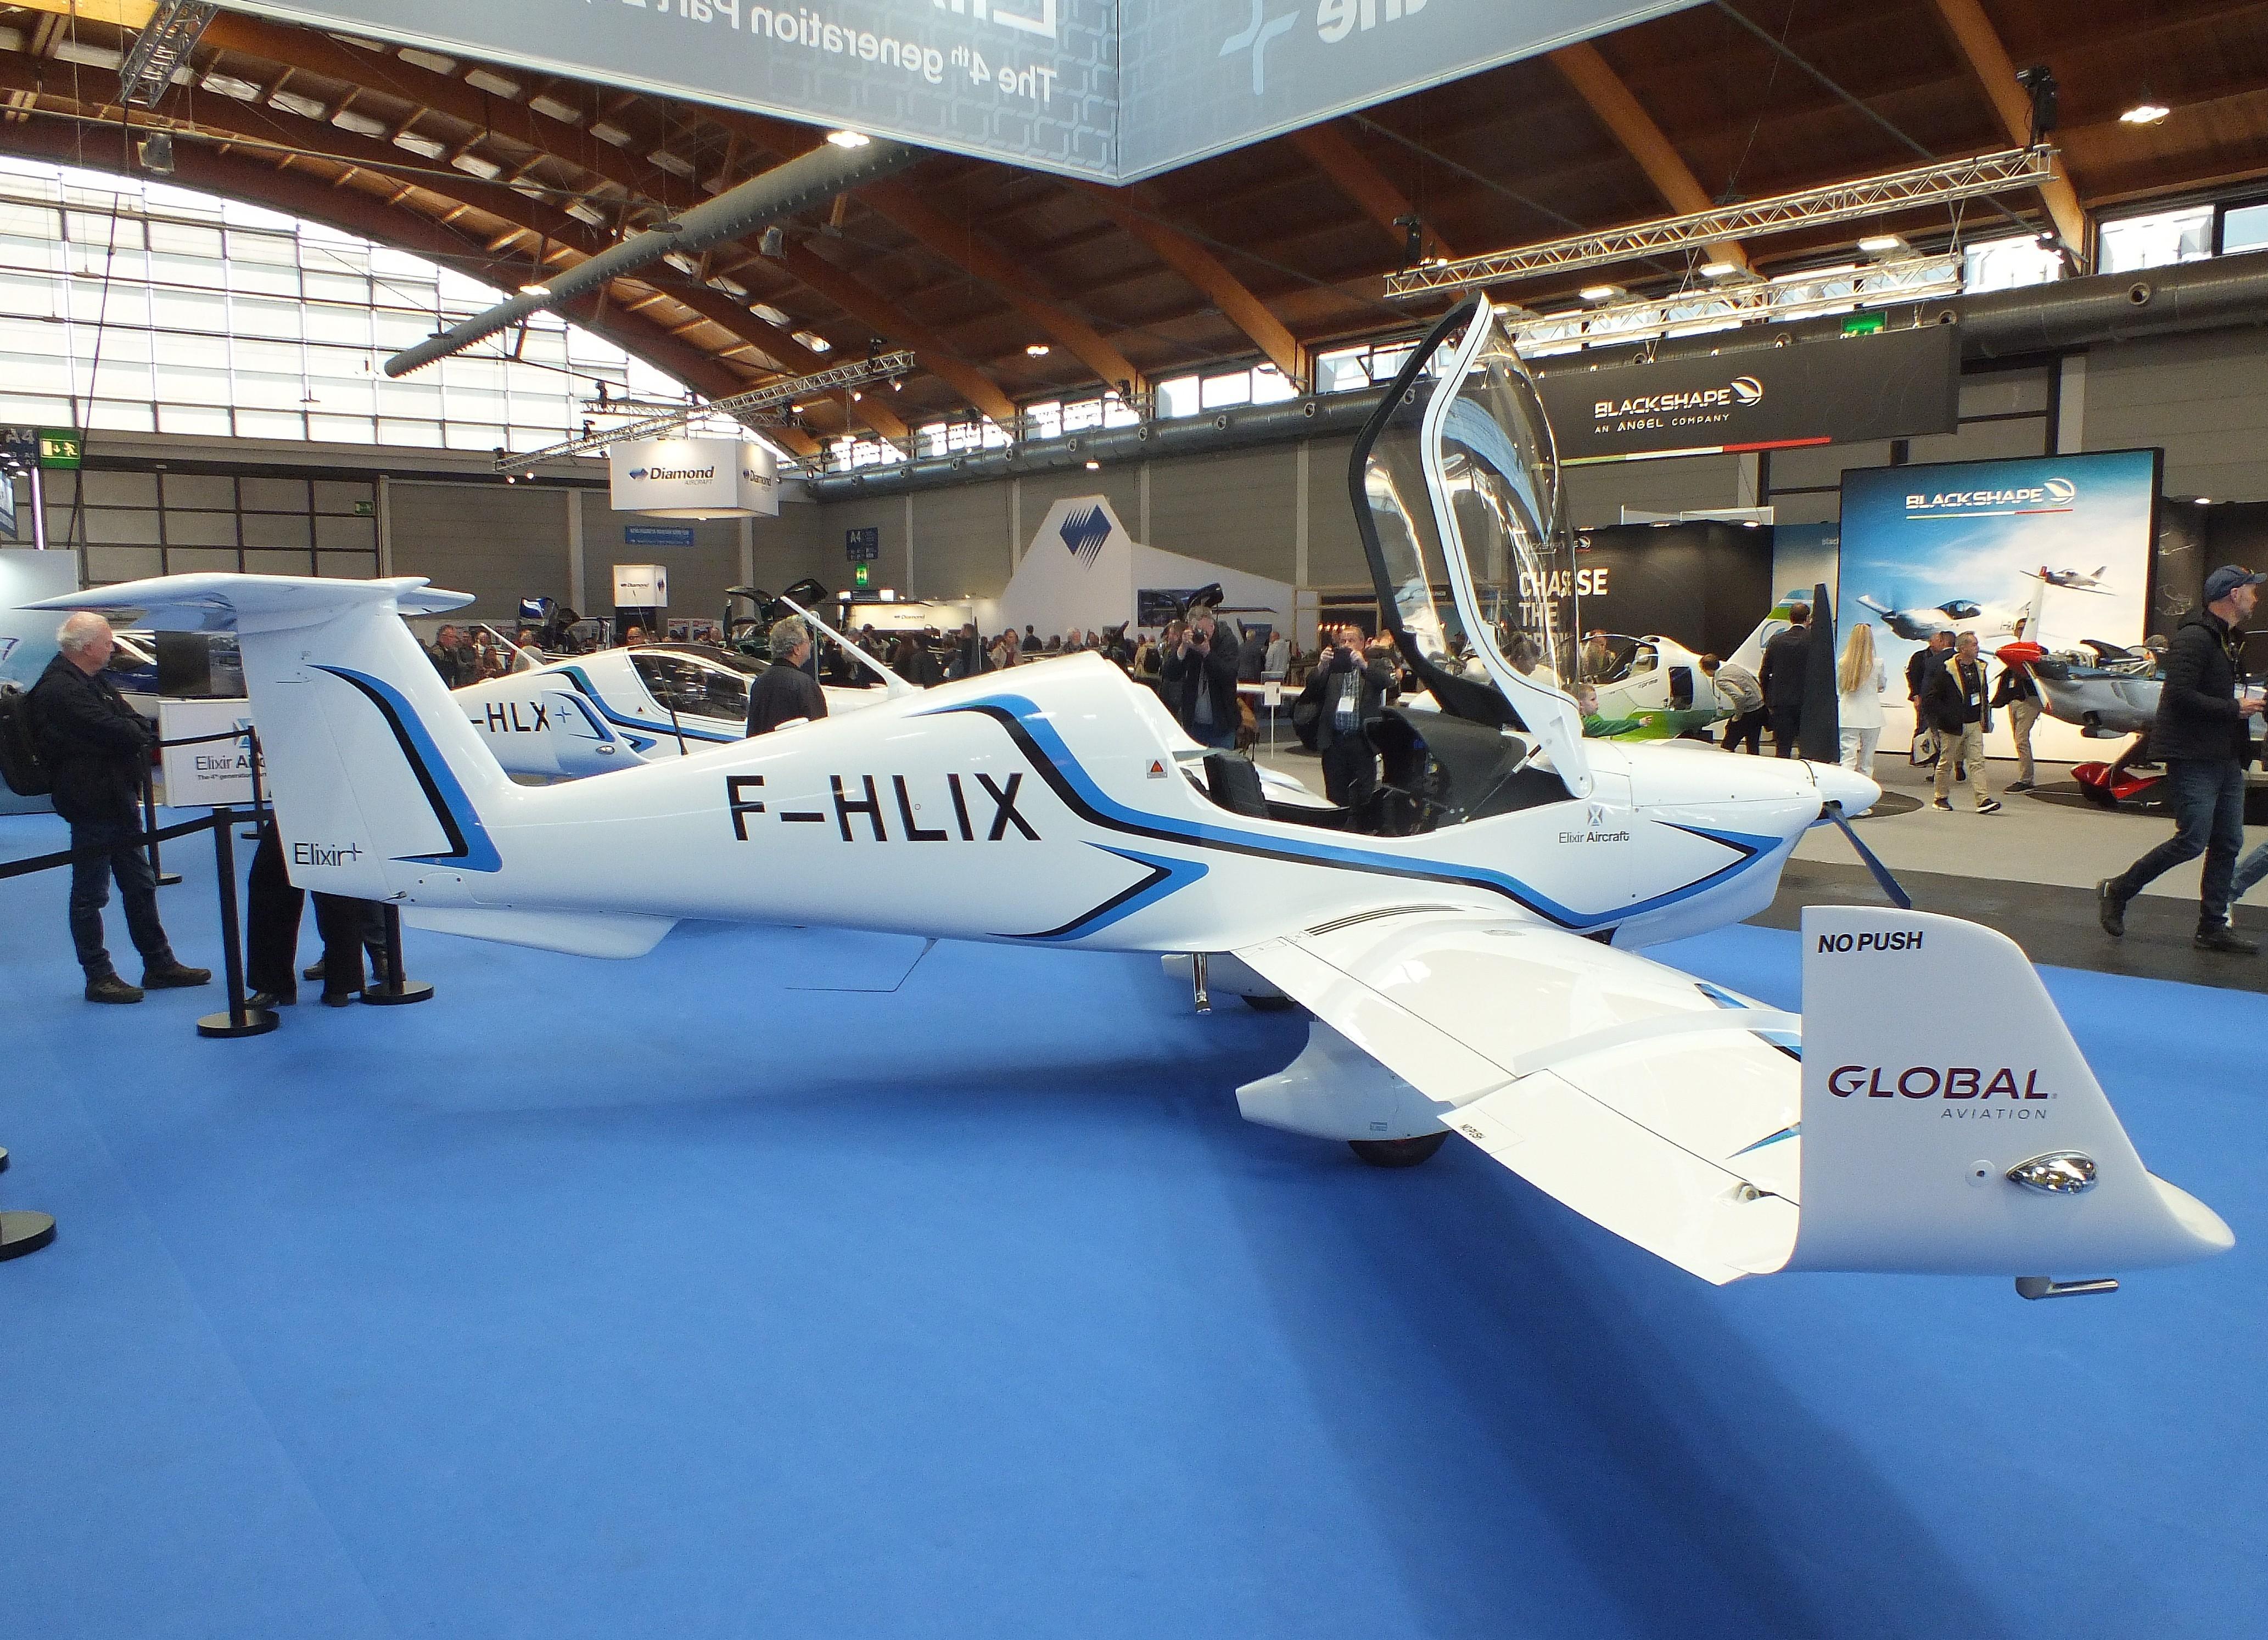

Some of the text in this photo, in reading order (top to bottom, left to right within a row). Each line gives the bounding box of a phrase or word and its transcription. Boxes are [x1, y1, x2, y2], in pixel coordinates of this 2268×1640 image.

[1594, 389, 1731, 419] BLACKSHAPE
[1594, 413, 1730, 434] AN ANGEL COMPANY
[649, 465, 714, 480] Diamond
[750, 469, 772, 487] Diamond
[1905, 487, 2045, 509] BLACKSHAPE
[195, 755, 233, 771] Elixir
[726, 772, 1042, 842] F-HLIX
[1559, 830, 1630, 844] Elixir Aircraft
[1818, 930, 1924, 953] NO PUSH
[1827, 1065, 2049, 1099] GLOBAL
[1940, 1108, 2047, 1120] AVIATION
